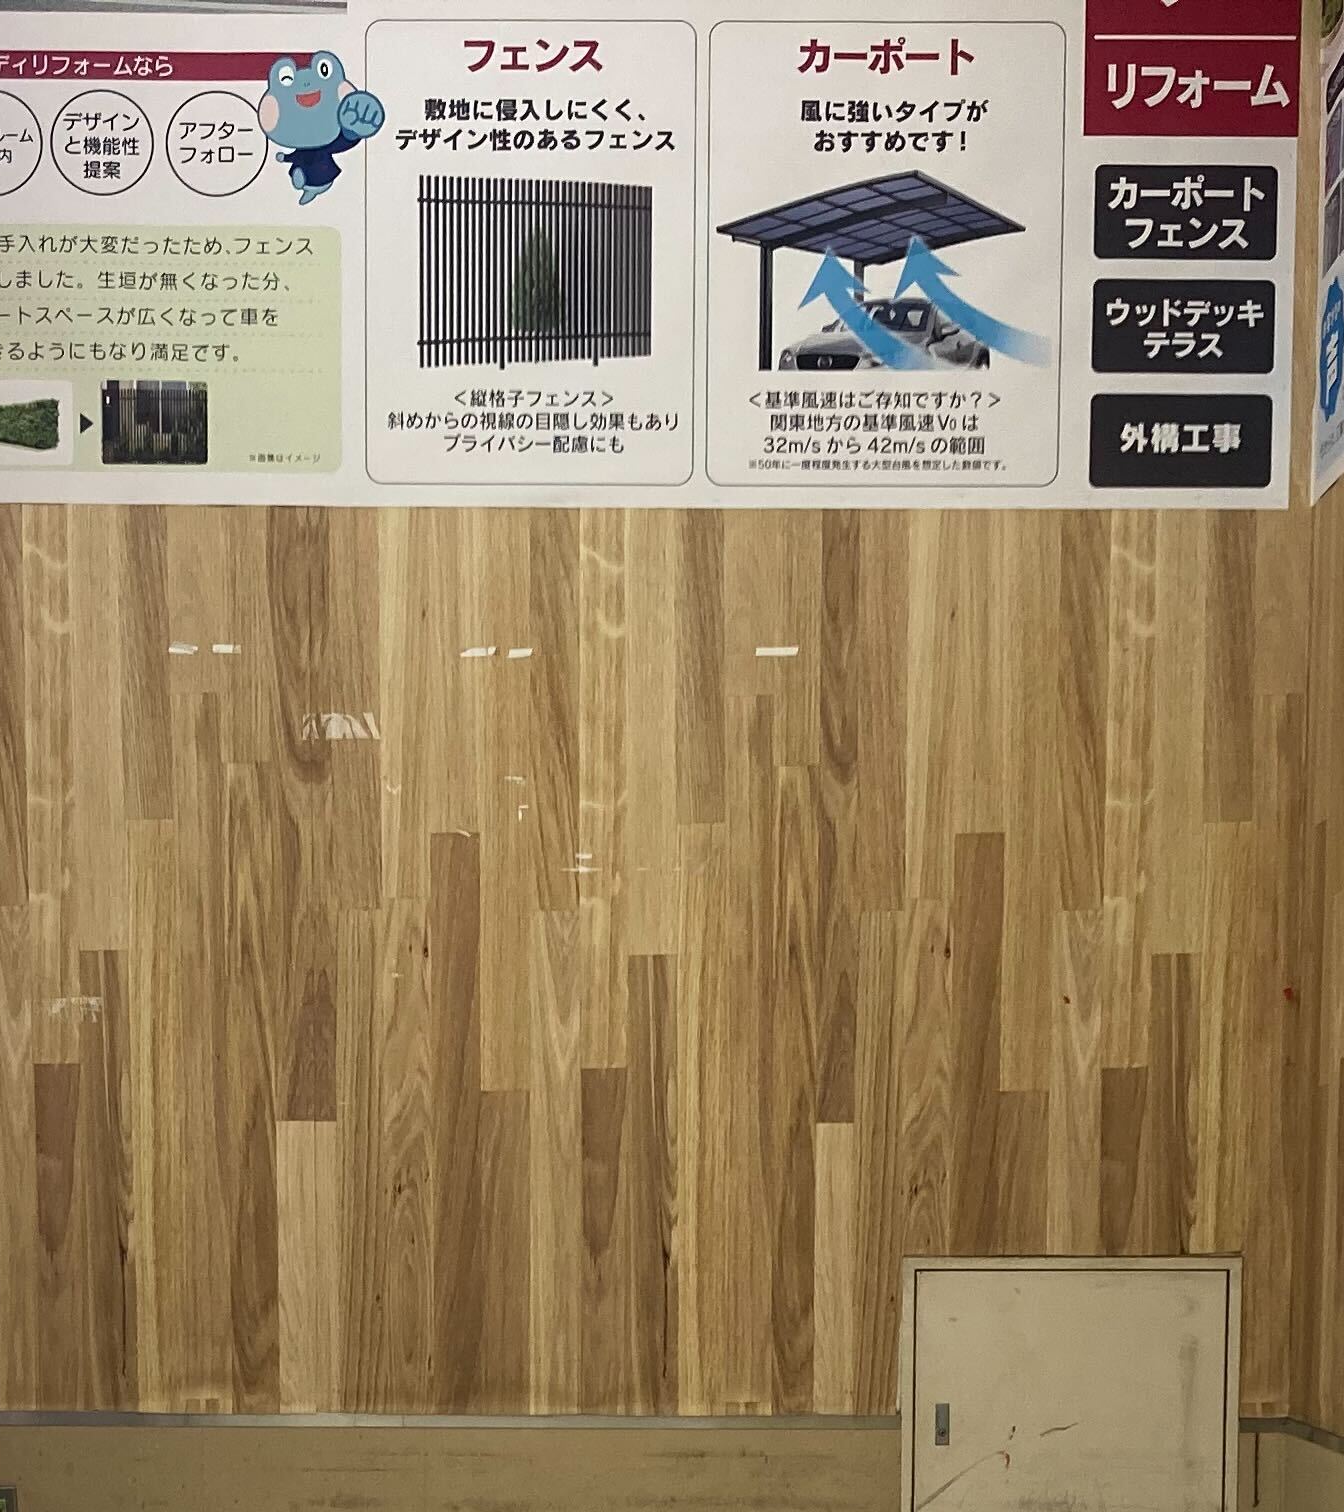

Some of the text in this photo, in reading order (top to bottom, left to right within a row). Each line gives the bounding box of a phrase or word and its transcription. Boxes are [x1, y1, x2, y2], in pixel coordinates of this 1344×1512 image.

[464, 38, 603, 73] フェンス
[797, 39, 975, 75] カーポート
[1105, 64, 1291, 108] リフォーム
[63, 112, 140, 131] デザイン
[423, 98, 647, 123] 敷地に侵入しにくく、
[801, 99, 988, 124] 風に強いタイプが
[179, 122, 254, 141] アフター
[395, 128, 676, 153] デザイン性のあるフェンス
[64, 136, 140, 156] と機能性
[179, 146, 254, 163] フォロー
[83, 161, 121, 180] 提案
[1108, 176, 1265, 211] カーポート
[1124, 219, 1249, 250] フェンス
[1105, 296, 1265, 328] ウッドデッキ
[1143, 331, 1223, 359] テラス
[388, 409, 679, 431] 斜めからの視線の目隠し効果もあり
[444, 433, 624, 454] プライバシー配慮にも
[1120, 422, 1241, 455] 外構工事
